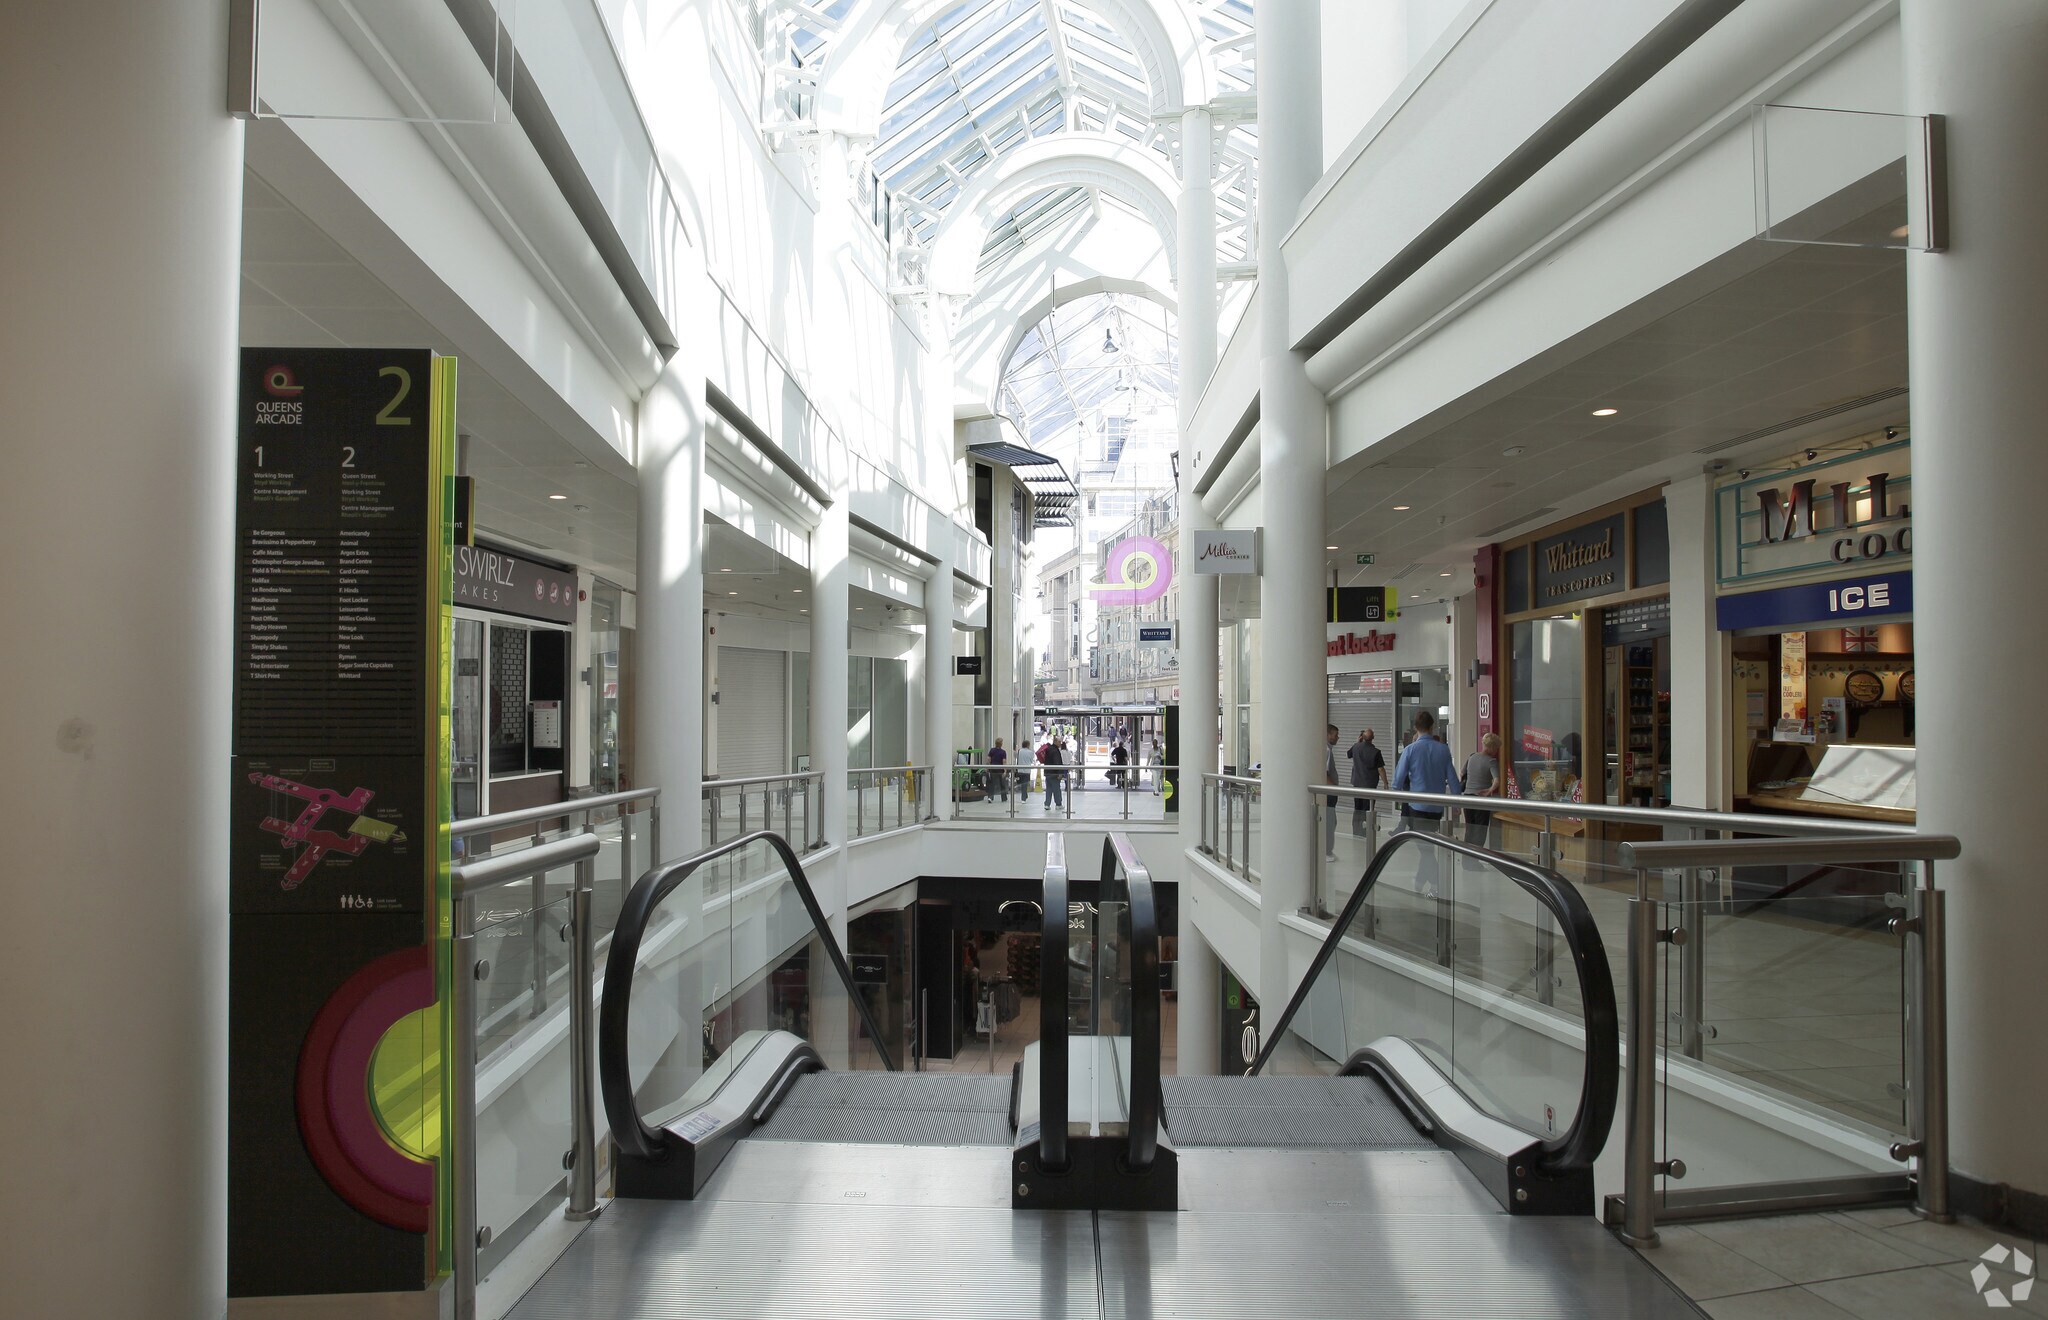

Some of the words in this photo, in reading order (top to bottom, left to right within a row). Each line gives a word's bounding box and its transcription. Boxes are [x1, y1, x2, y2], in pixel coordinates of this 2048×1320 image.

[376, 366, 411, 425] 2
[256, 402, 302, 413] QUEENS
[256, 414, 302, 424] ARCADE
[254, 446, 263, 467] 1
[342, 446, 355, 468] 2
[1200, 542, 1237, 560] Millie's
[1544, 528, 1614, 574] Whittard
[459, 547, 515, 586] SWIRLZ
[1829, 583, 1890, 612] ICE
[1346, 630, 1396, 654] Locker
[311, 804, 322, 813] 2
